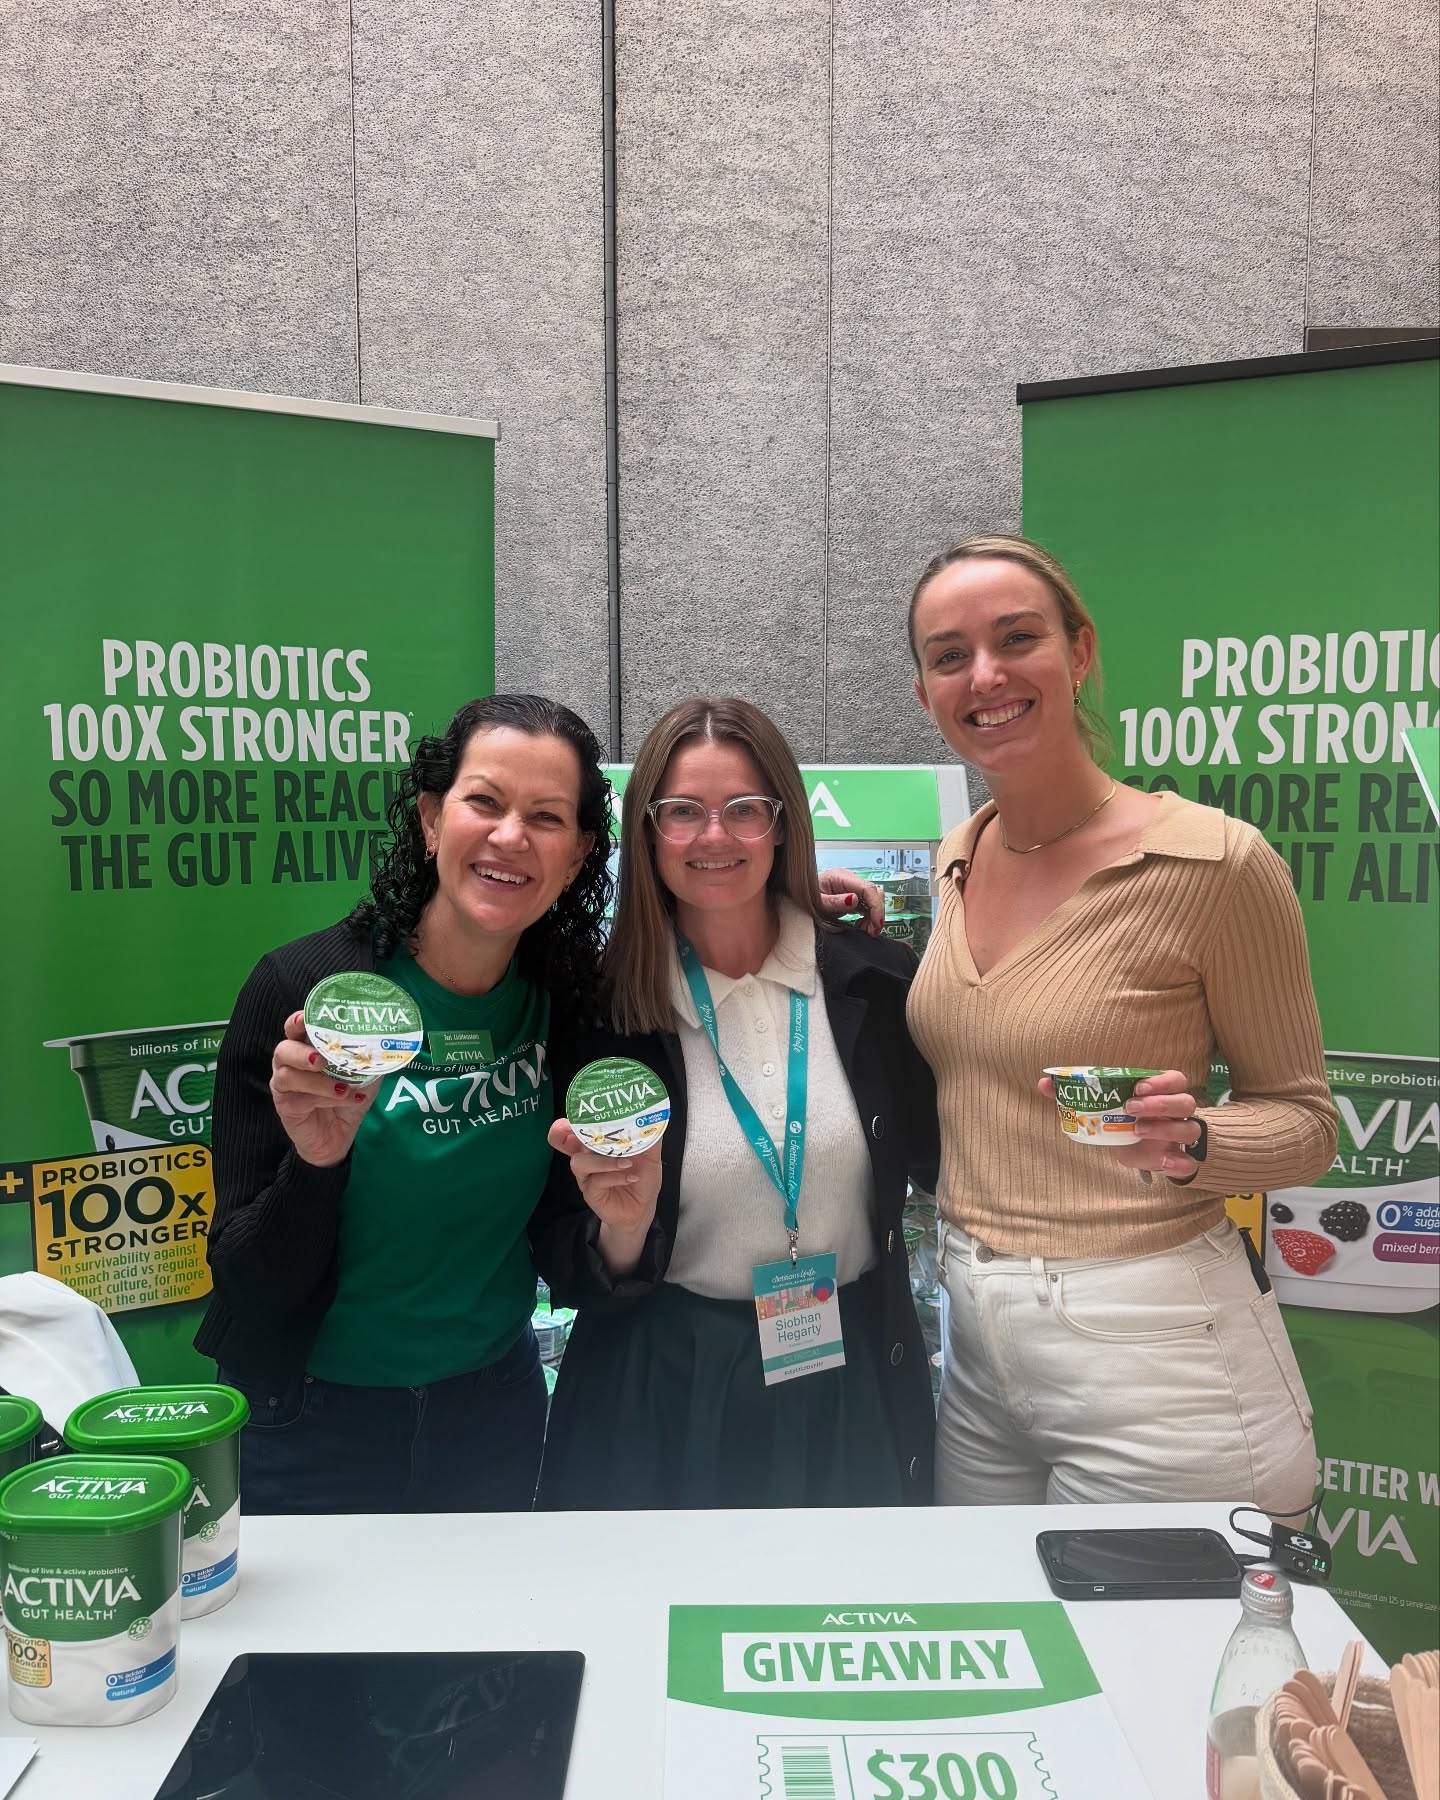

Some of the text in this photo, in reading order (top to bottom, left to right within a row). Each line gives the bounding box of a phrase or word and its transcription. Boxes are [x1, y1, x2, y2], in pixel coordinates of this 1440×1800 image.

[103, 639, 371, 702] PROBIOTICS
[44, 703, 168, 762] 100X
[1119, 701, 1438, 767] 100X STRON
[48, 769, 111, 826] SO
[128, 769, 260, 825] MORE
[1198, 772, 1437, 833] MORE RE
[61, 833, 152, 892] THE
[167, 832, 257, 887] GUT
[1347, 842, 1438, 904] ALI
[316, 1003, 411, 1025] ACTIVIA
[335, 1023, 397, 1032] GUT HEALTH
[130, 1038, 221, 1057] billions of liv
[446, 1050, 485, 1062] ACTIVIA
[407, 1061, 441, 1072] illions
[444, 1064, 456, 1073] of
[458, 1064, 477, 1073] live
[1326, 1066, 1366, 1084] ctive
[130, 1063, 218, 1120] AC
[577, 1081, 658, 1118] ACTIVIA
[422, 1095, 540, 1135] GUT HEALTH
[594, 1102, 646, 1121] GUT HEALTH
[1079, 1101, 1109, 1109] HEALTH
[169, 1115, 210, 1137] GU
[42, 1149, 207, 1189] PROBIOTICS
[38, 1176, 209, 1239] 100x
[1381, 1204, 1413, 1227] 0%
[46, 1220, 209, 1262] STRONGER
[1382, 1242, 1417, 1254] mixed
[60, 1243, 198, 1276] in survivability against
[113, 1265, 138, 1280] acid
[141, 1264, 154, 1276] vs
[158, 1257, 200, 1275] regular
[106, 1278, 151, 1295] culture,
[155, 1275, 167, 1287] for
[175, 1269, 205, 1285] more
[116, 1295, 136, 1306] the
[139, 1289, 159, 1303] gut
[775, 1312, 822, 1332] Siobhan
[777, 1323, 822, 1343] Hegarty
[102, 1403, 209, 1420] ACTIVIA
[31, 1479, 147, 1494] ACTIVIA
[48, 1492, 72, 1500] GUT
[31, 1567, 40, 1575] of
[41, 1567, 54, 1575] live
[88, 1566, 129, 1576] probiotics
[182, 1573, 196, 1584] 0%
[4, 1572, 142, 1608] ACTIVIA
[185, 1584, 207, 1593] natural
[1325, 1586, 1343, 1595] mach
[21, 1607, 116, 1621] GUT HEALTH
[821, 1611, 918, 1626] ACTIVIA
[742, 1639, 1010, 1683] GIVEAWAY
[107, 1667, 147, 1686] 0% added
[125, 1674, 144, 1683] sugar
[111, 1687, 137, 1697] natural
[866, 1748, 1019, 1800] $300
